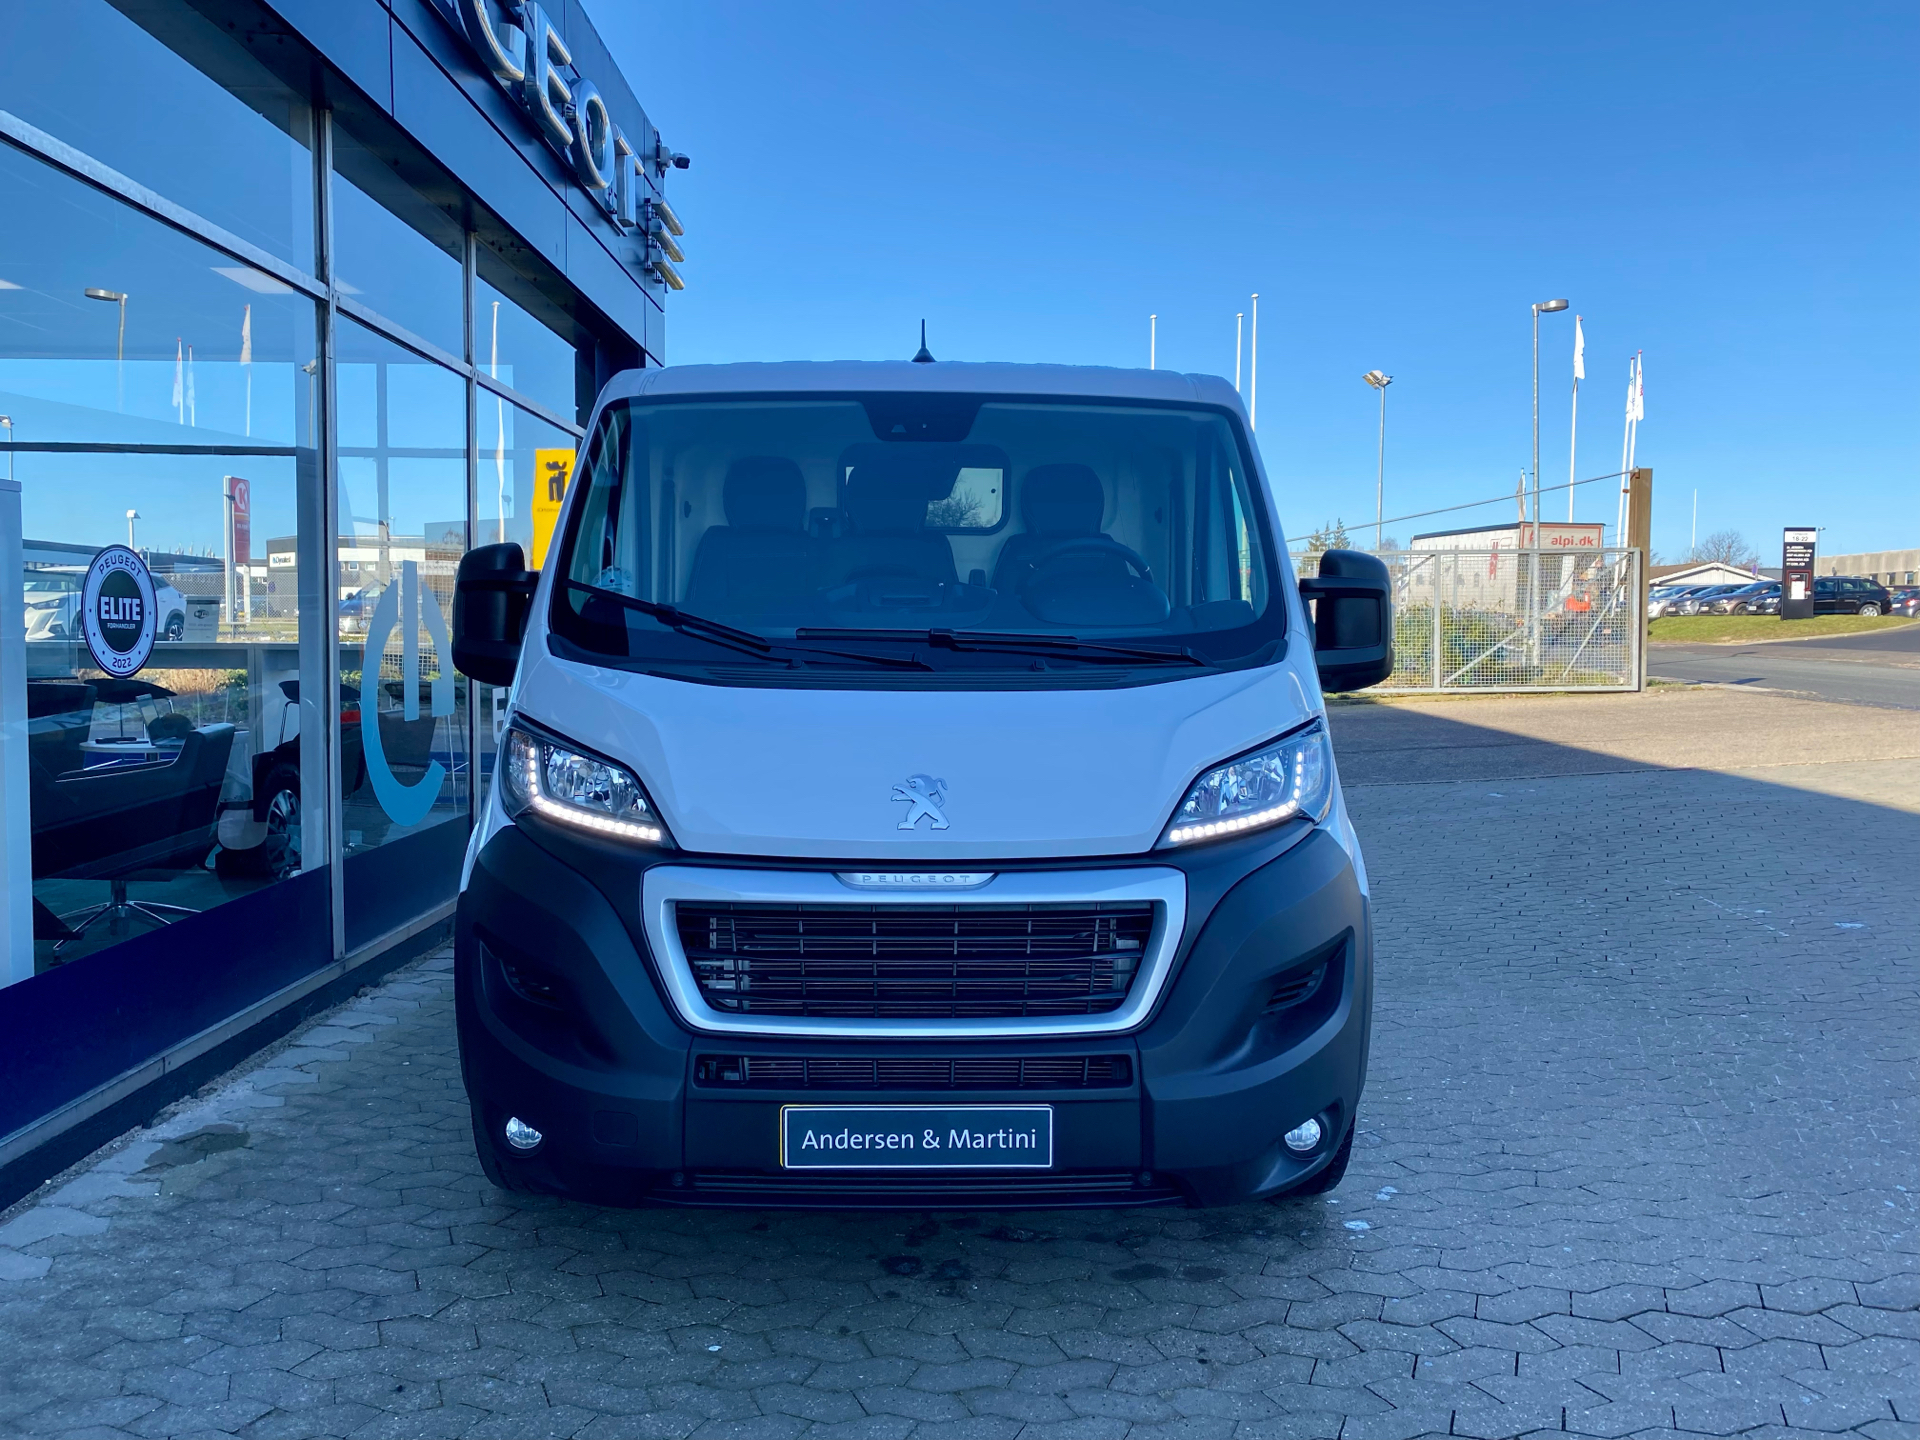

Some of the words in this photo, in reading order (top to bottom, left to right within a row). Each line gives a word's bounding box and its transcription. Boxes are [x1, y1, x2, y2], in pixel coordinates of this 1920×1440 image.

[1551, 535, 1594, 548] alpi.dk
[98, 554, 142, 577] PEUGEOT
[100, 596, 141, 620] ELITE
[112, 657, 132, 669] 2022
[862, 875, 971, 884] PEUGEOT
[801, 1128, 914, 1150] Andersen
[922, 1129, 941, 1149] &
[948, 1128, 1037, 1149] Martini
